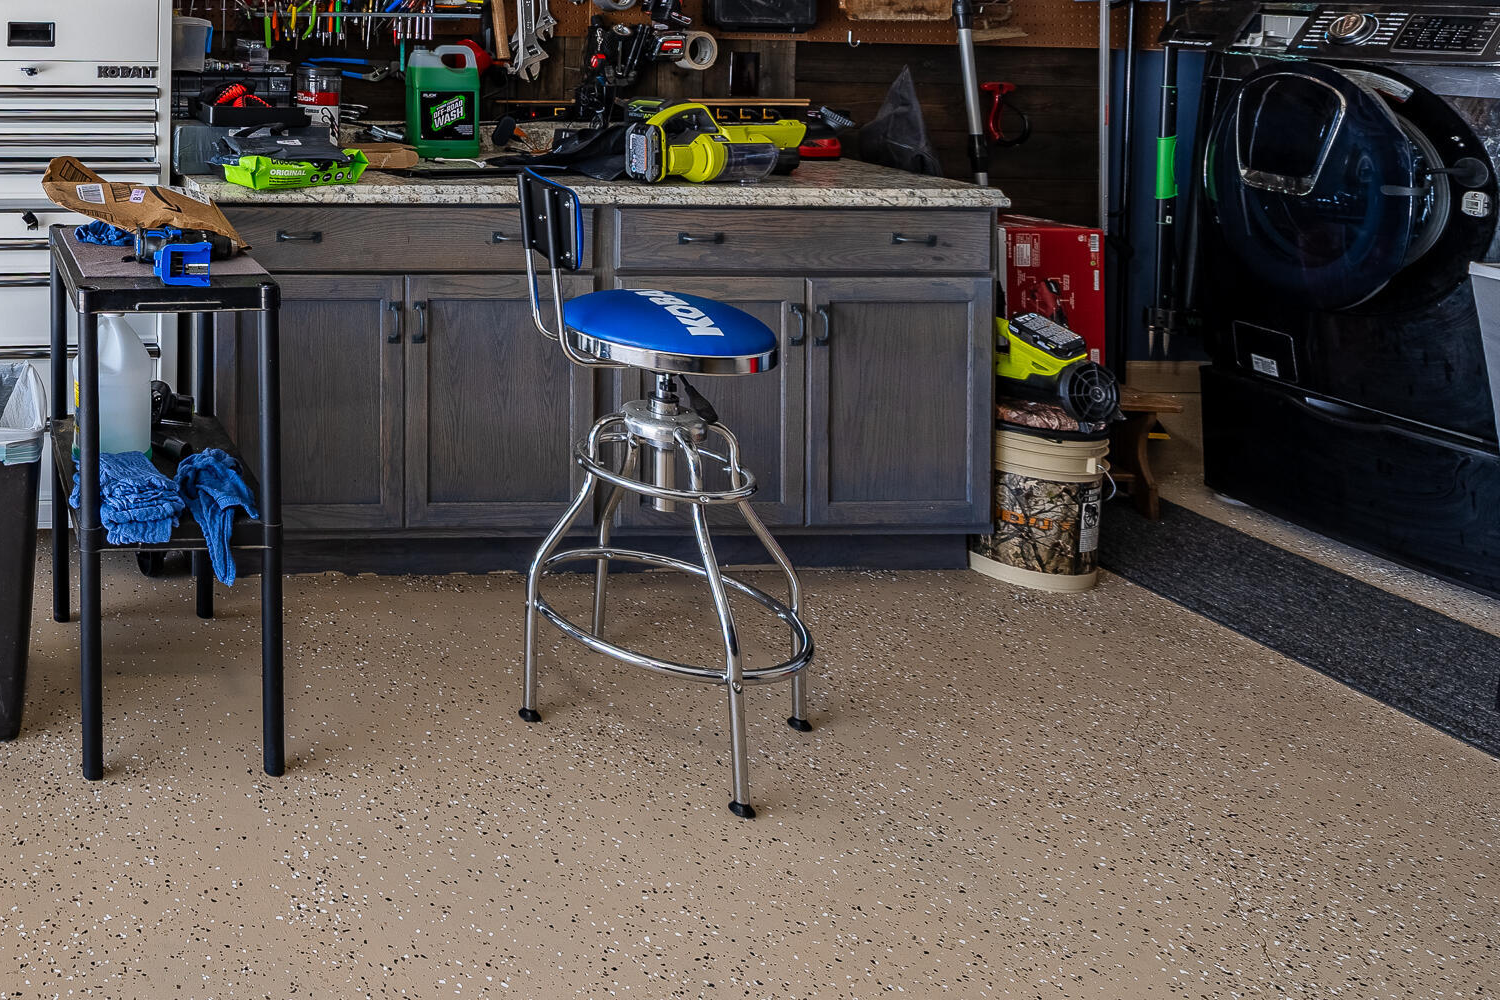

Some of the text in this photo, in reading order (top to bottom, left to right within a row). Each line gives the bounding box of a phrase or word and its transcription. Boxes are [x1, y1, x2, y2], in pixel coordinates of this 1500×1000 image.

[97, 65, 159, 79] KOBALT
[433, 99, 463, 119] OFF-ROAD
[434, 106, 464, 129] WASH
